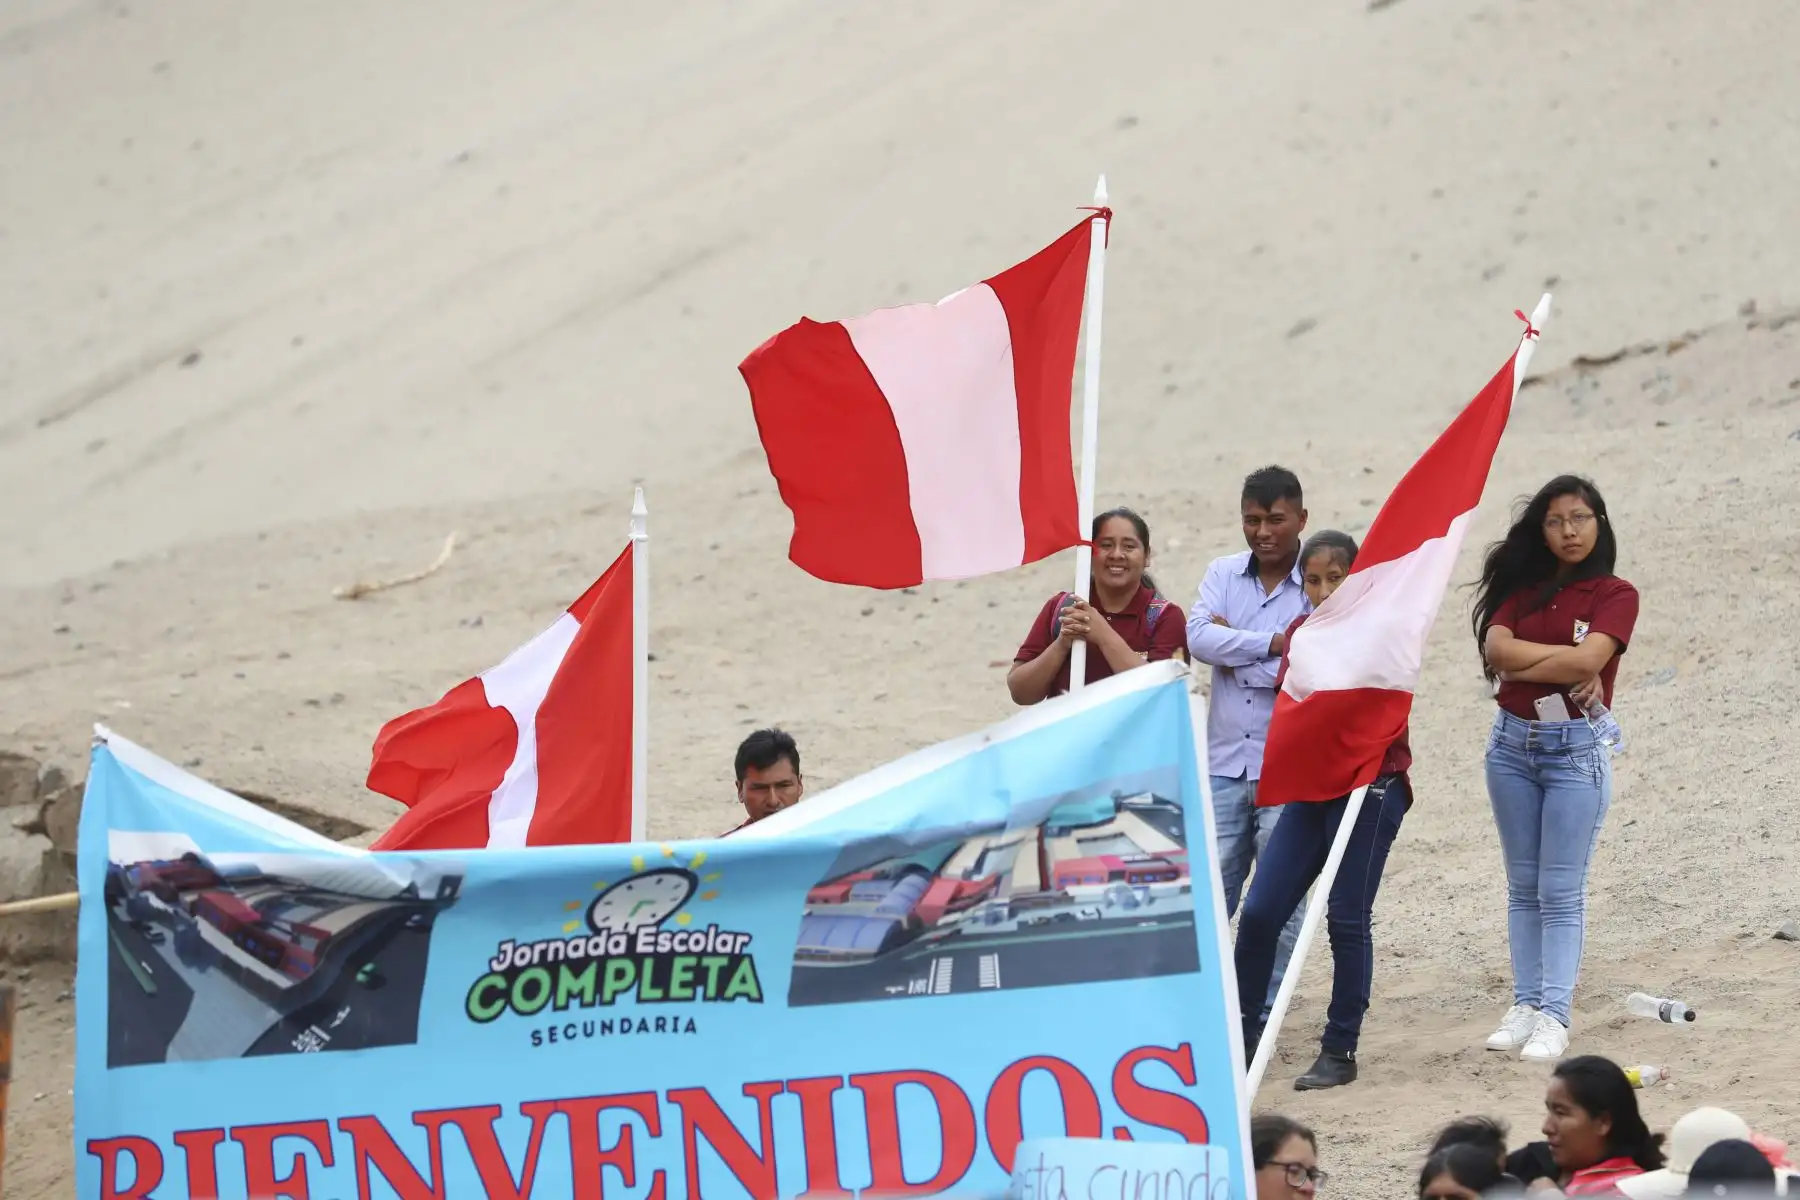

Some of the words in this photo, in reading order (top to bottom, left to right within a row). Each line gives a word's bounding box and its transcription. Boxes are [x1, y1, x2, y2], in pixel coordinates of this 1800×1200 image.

[490, 929, 628, 972] Jornada
[635, 924, 752, 955] Escolar
[465, 954, 764, 1024] COMPLETA
[531, 1016, 698, 1047] SECUNDARIA
